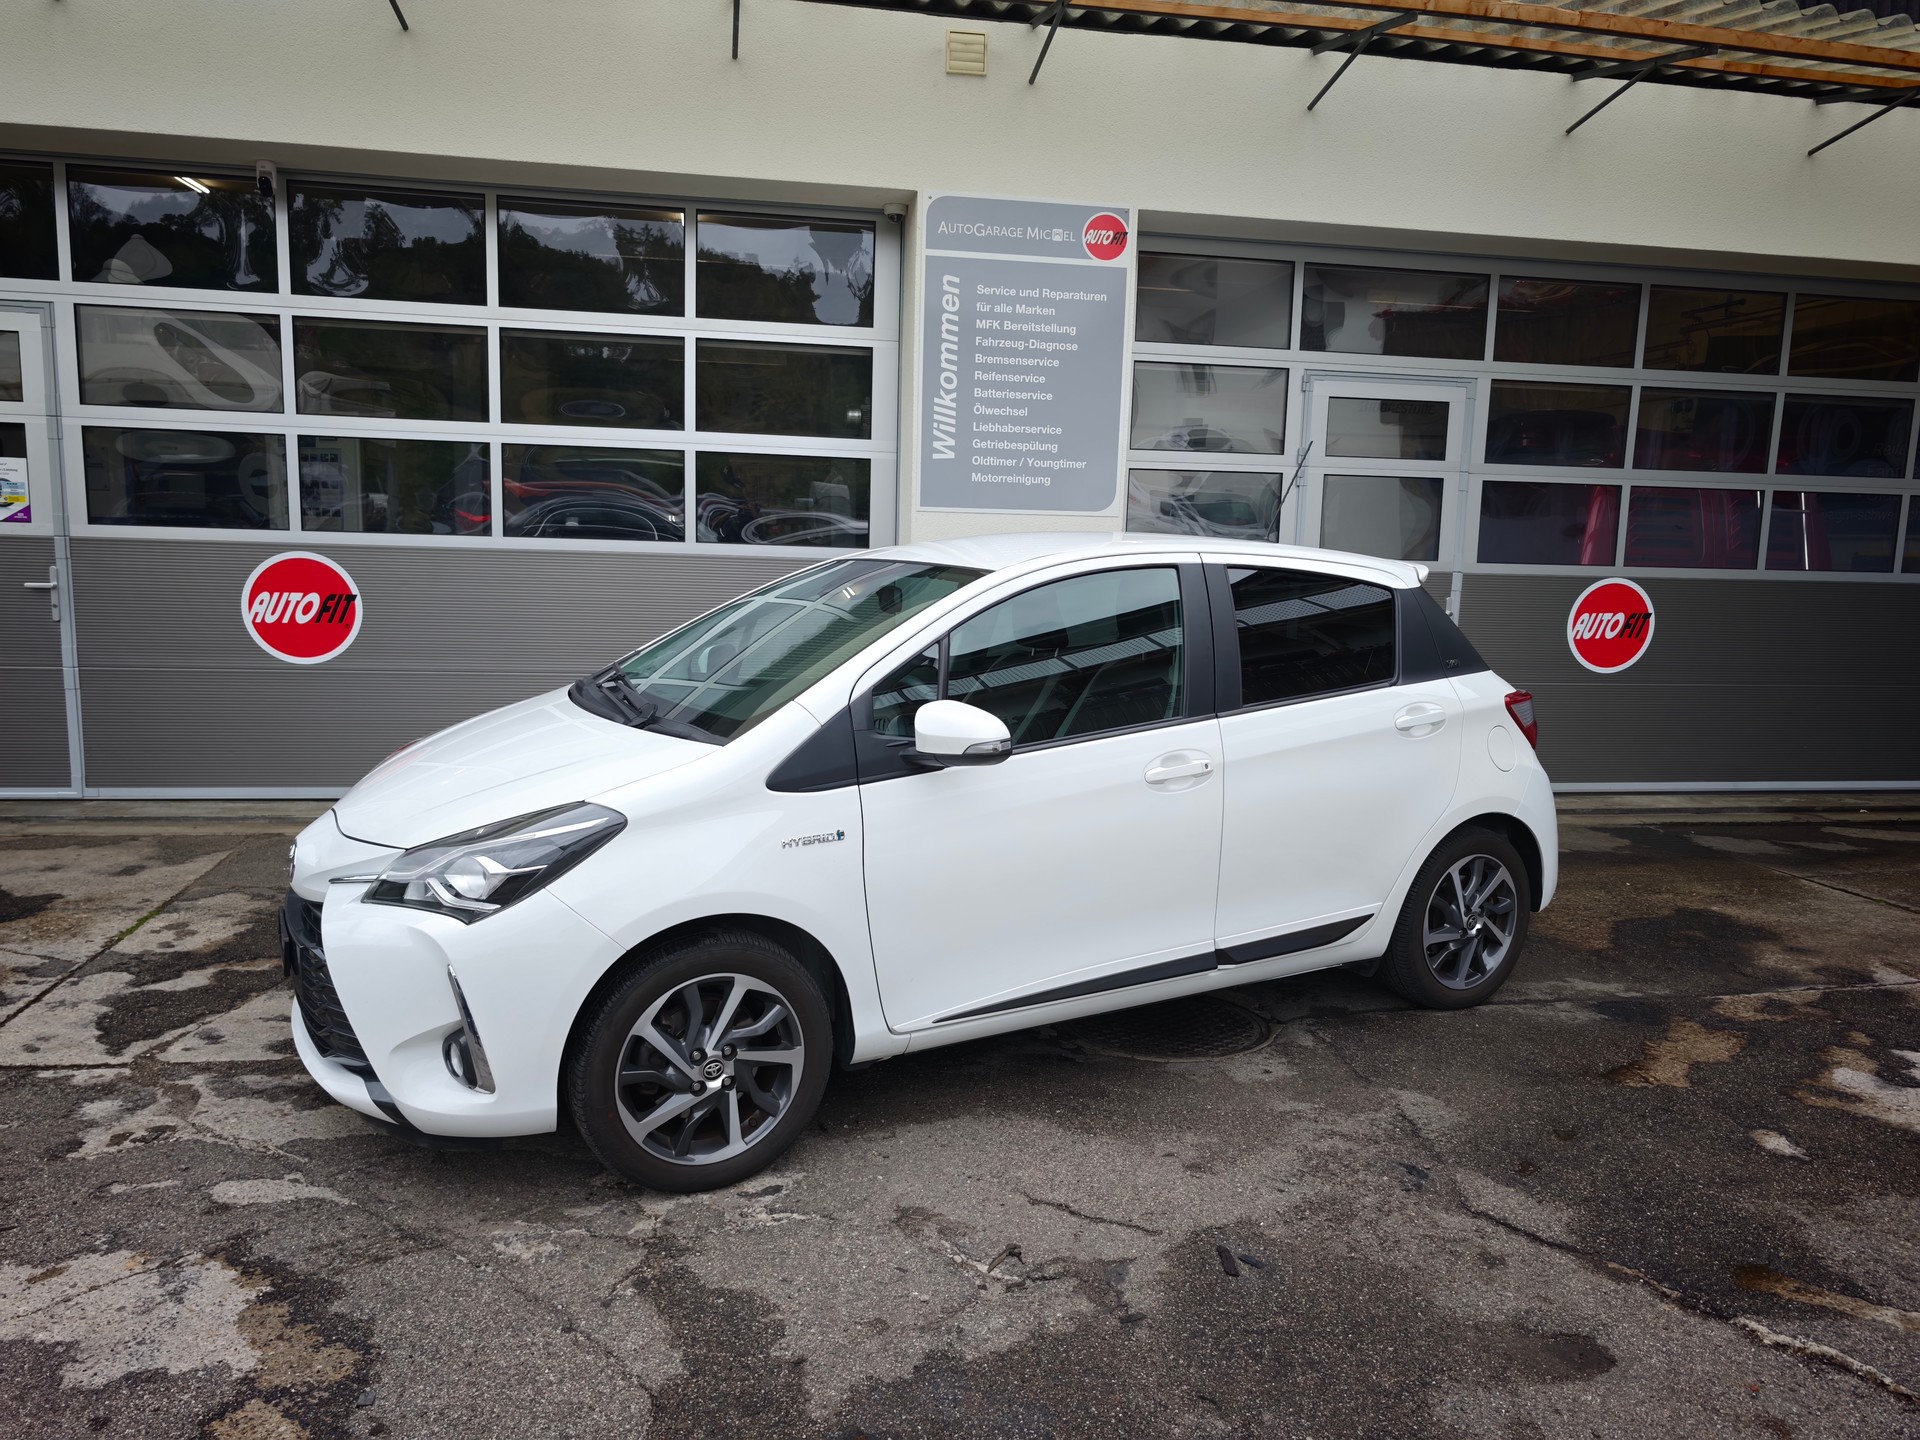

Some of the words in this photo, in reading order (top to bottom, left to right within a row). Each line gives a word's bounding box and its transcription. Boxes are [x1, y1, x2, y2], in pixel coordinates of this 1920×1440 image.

[1084, 229, 1129, 246] AUTOFIT
[976, 284, 1017, 297] Service
[1019, 287, 1040, 298] und
[1042, 288, 1107, 302] Reparaturen
[976, 302, 992, 313] für
[994, 303, 1013, 314] alle
[1015, 304, 1056, 316] Marken
[975, 319, 1001, 331] MFK
[1003, 320, 1077, 336] Bereitstellung
[975, 336, 1079, 351] Fahrzeug-Diagnose
[932, 274, 960, 460] Willkommen
[975, 353, 1060, 367] Bremsenservice
[974, 370, 1046, 383] Reifenservice
[973, 387, 1053, 401] Batterieservice
[973, 403, 1028, 416] Ölwechsel
[972, 422, 1063, 435] Liebhaberservice
[972, 439, 1058, 453] Getriebespülung
[971, 456, 1017, 467] Oldtimer
[1027, 457, 1087, 470] Youngtimer
[971, 472, 1051, 486] Motorreinigung
[250, 591, 357, 624] AUTOFIT
[1572, 612, 1653, 640] AUTOFIT
[781, 832, 835, 849] HYBRID
